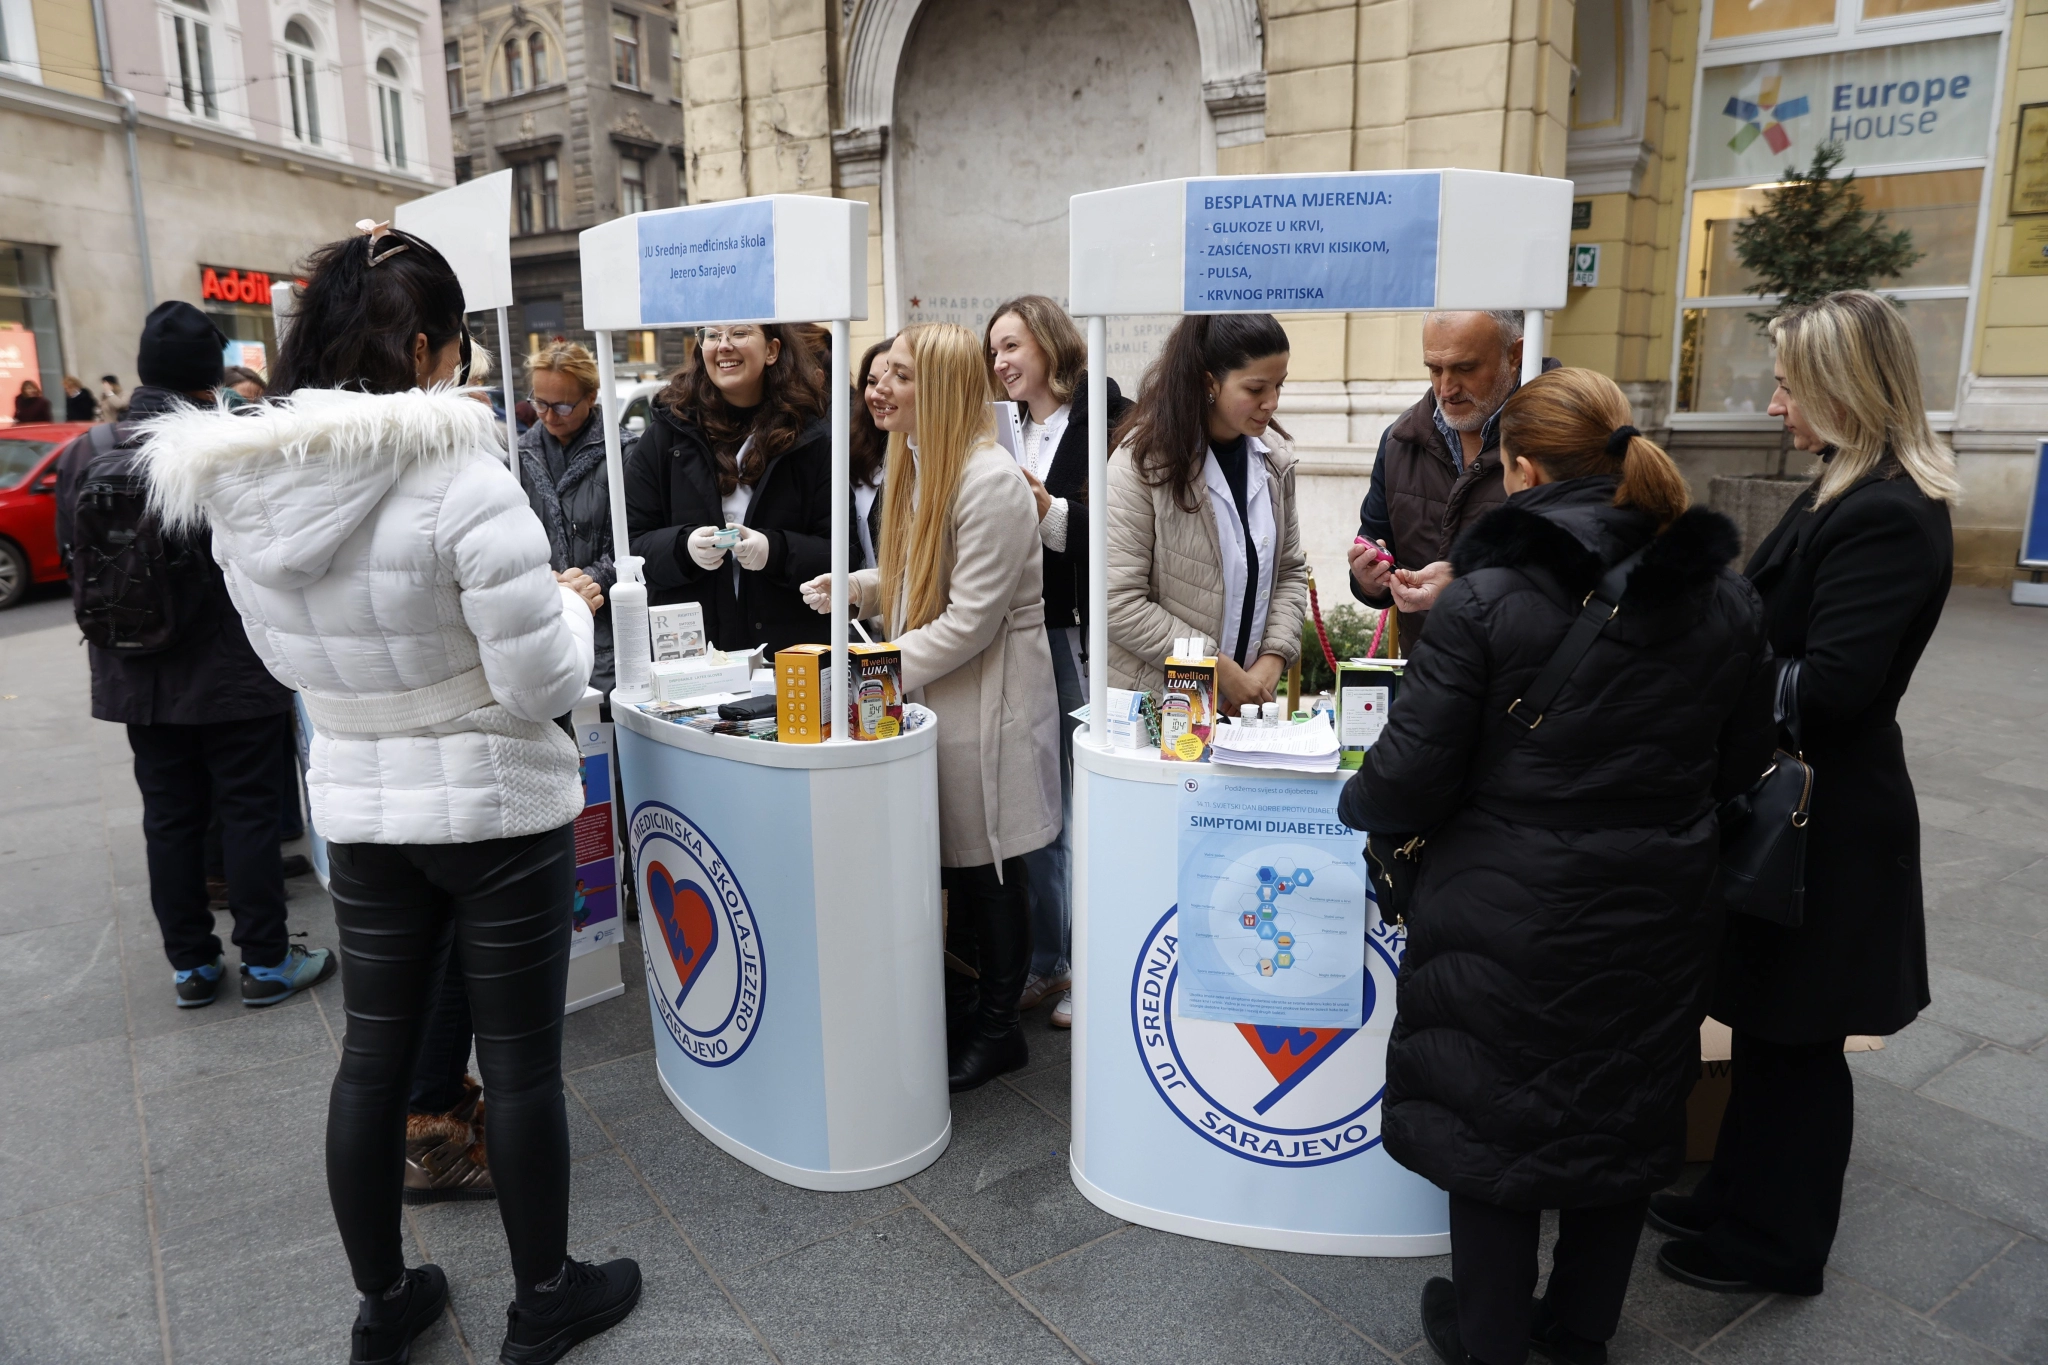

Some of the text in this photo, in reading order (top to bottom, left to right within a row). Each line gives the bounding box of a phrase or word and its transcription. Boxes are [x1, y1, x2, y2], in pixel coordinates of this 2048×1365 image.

[1831, 73, 1971, 113] Europe
[1829, 110, 1938, 143] House
[1203, 190, 1393, 210] BESPLATNA MJERENJA:
[1212, 221, 1272, 233] GLUKOZE
[1276, 221, 1286, 232] U
[1289, 219, 1324, 233] KRVI,
[644, 233, 766, 259] JU Srednja medicinska škola
[1207, 240, 1291, 256] ZASIĆENOSTI
[1294, 242, 1325, 254] KRVI
[1328, 240, 1390, 255] KISIKOM,
[669, 262, 737, 280] Jezero Sarajevo
[1207, 266, 1252, 280] PULSA,
[1575, 273, 1595, 283] AED
[1207, 288, 1263, 301] KRVNOG
[1266, 286, 1324, 300] PRITISKA
[862, 664, 889, 676] LUNA
[869, 656, 898, 667] wellion
[1167, 679, 1198, 690] LUNA
[1176, 671, 1210, 681] wellion
[1224, 784, 1257, 793] Podižemo
[1257, 786, 1278, 795] svijest
[1212, 802, 1241, 810] SVJETSKI
[1282, 806, 1307, 814] PROTIV
[1307, 807, 1339, 815] DIJABETE
[1190, 815, 1354, 836] SIMPTOMI DIJABETESA
[634, 812, 703, 859] MEDICINSKA
[1142, 934, 1179, 1048] SREDNJA
[659, 996, 728, 1059] SARAJEVO
[1155, 1061, 1187, 1091] JU
[1198, 1110, 1369, 1158] SARAJEVO
